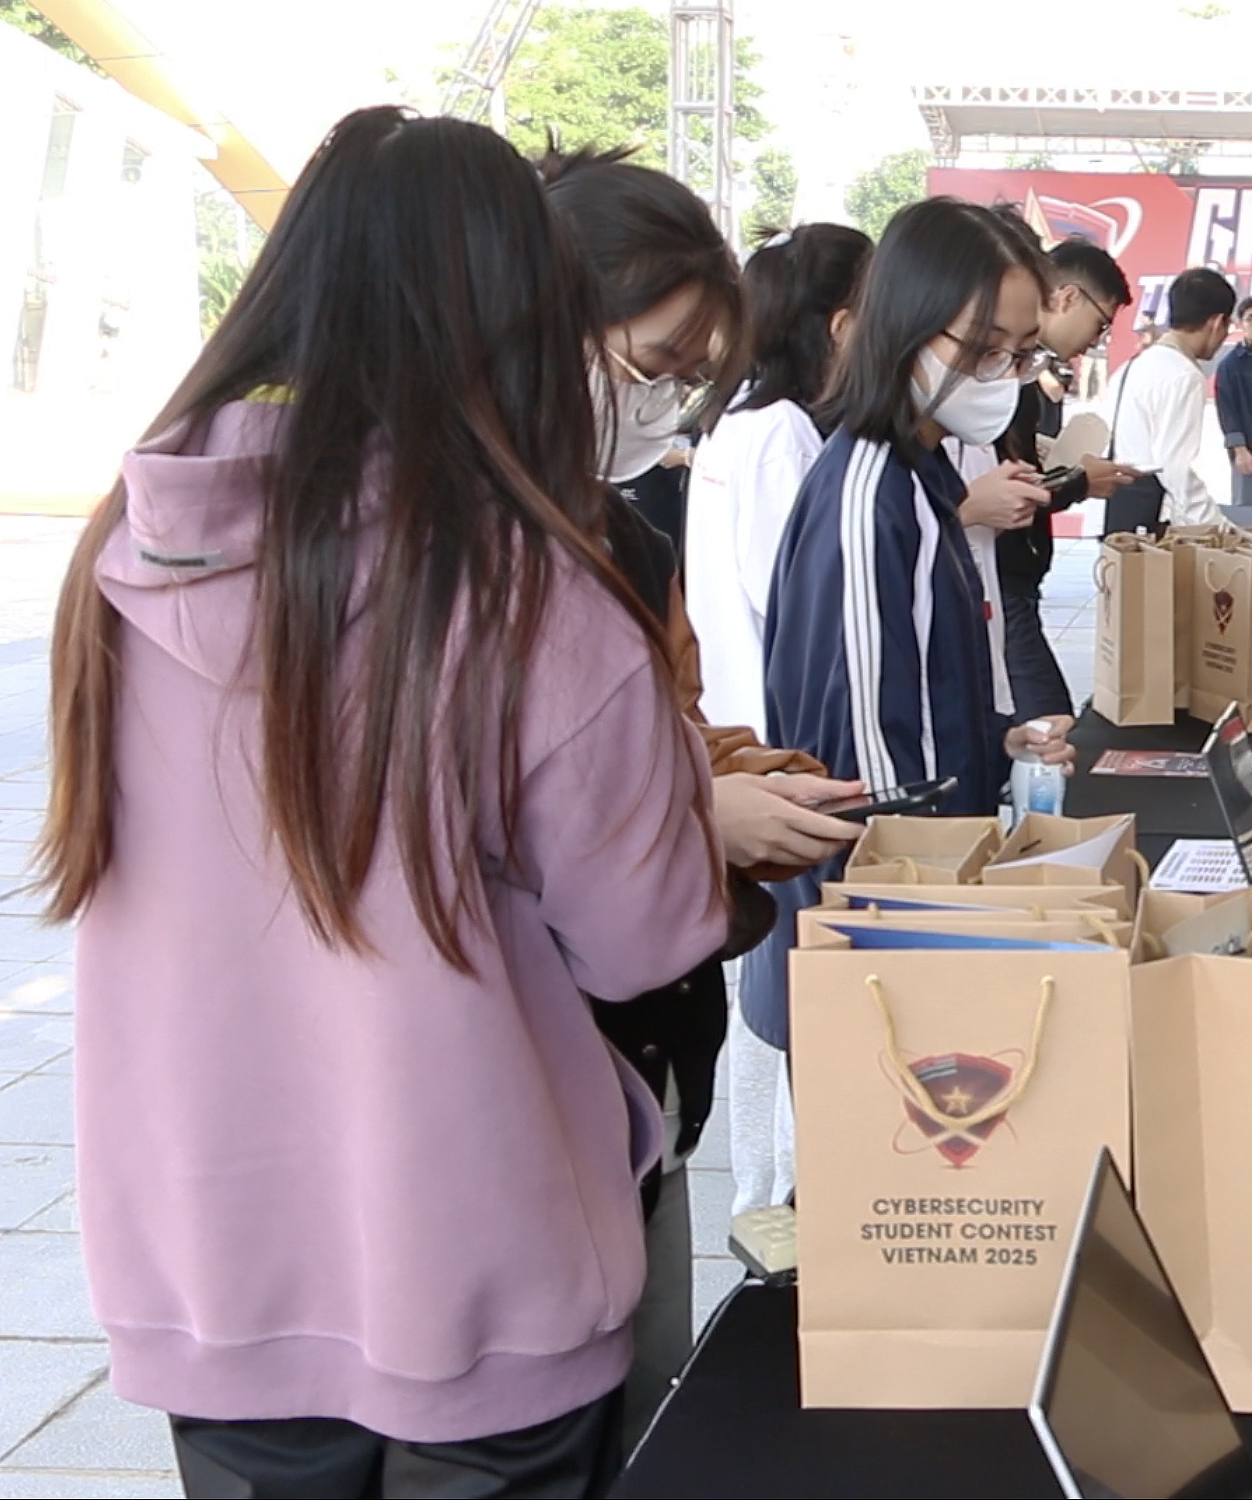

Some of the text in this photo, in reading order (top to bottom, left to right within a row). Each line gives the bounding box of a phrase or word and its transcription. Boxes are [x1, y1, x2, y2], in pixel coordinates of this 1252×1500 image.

[872, 1198, 1045, 1216] CYBERSECURITY
[861, 1222, 1058, 1241] STUDENT CONTEST
[881, 1247, 1037, 1266] VIETNAM 2025
